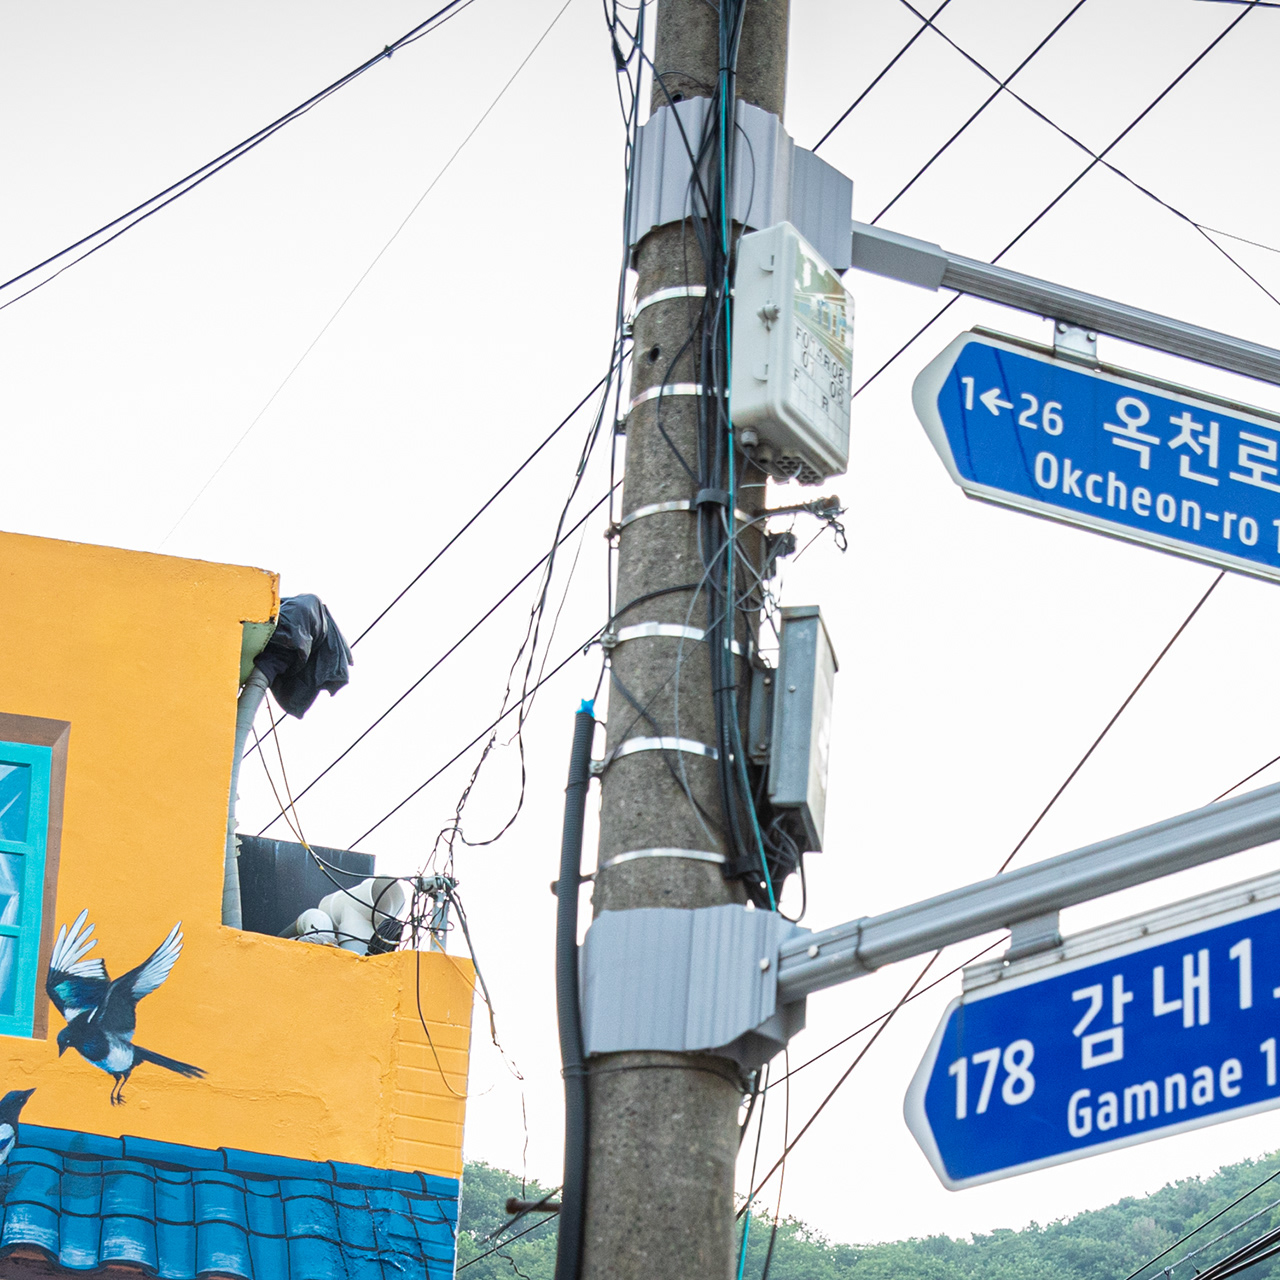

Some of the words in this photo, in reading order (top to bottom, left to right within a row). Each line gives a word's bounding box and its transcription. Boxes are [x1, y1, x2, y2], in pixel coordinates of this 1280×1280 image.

[960, 377, 974, 410] 1
[1019, 393, 1064, 436] 26
[1034, 451, 1259, 546] Okcheon-ro
[948, 1039, 1035, 1120] 178
[1067, 1057, 1243, 1138] Gamnae
